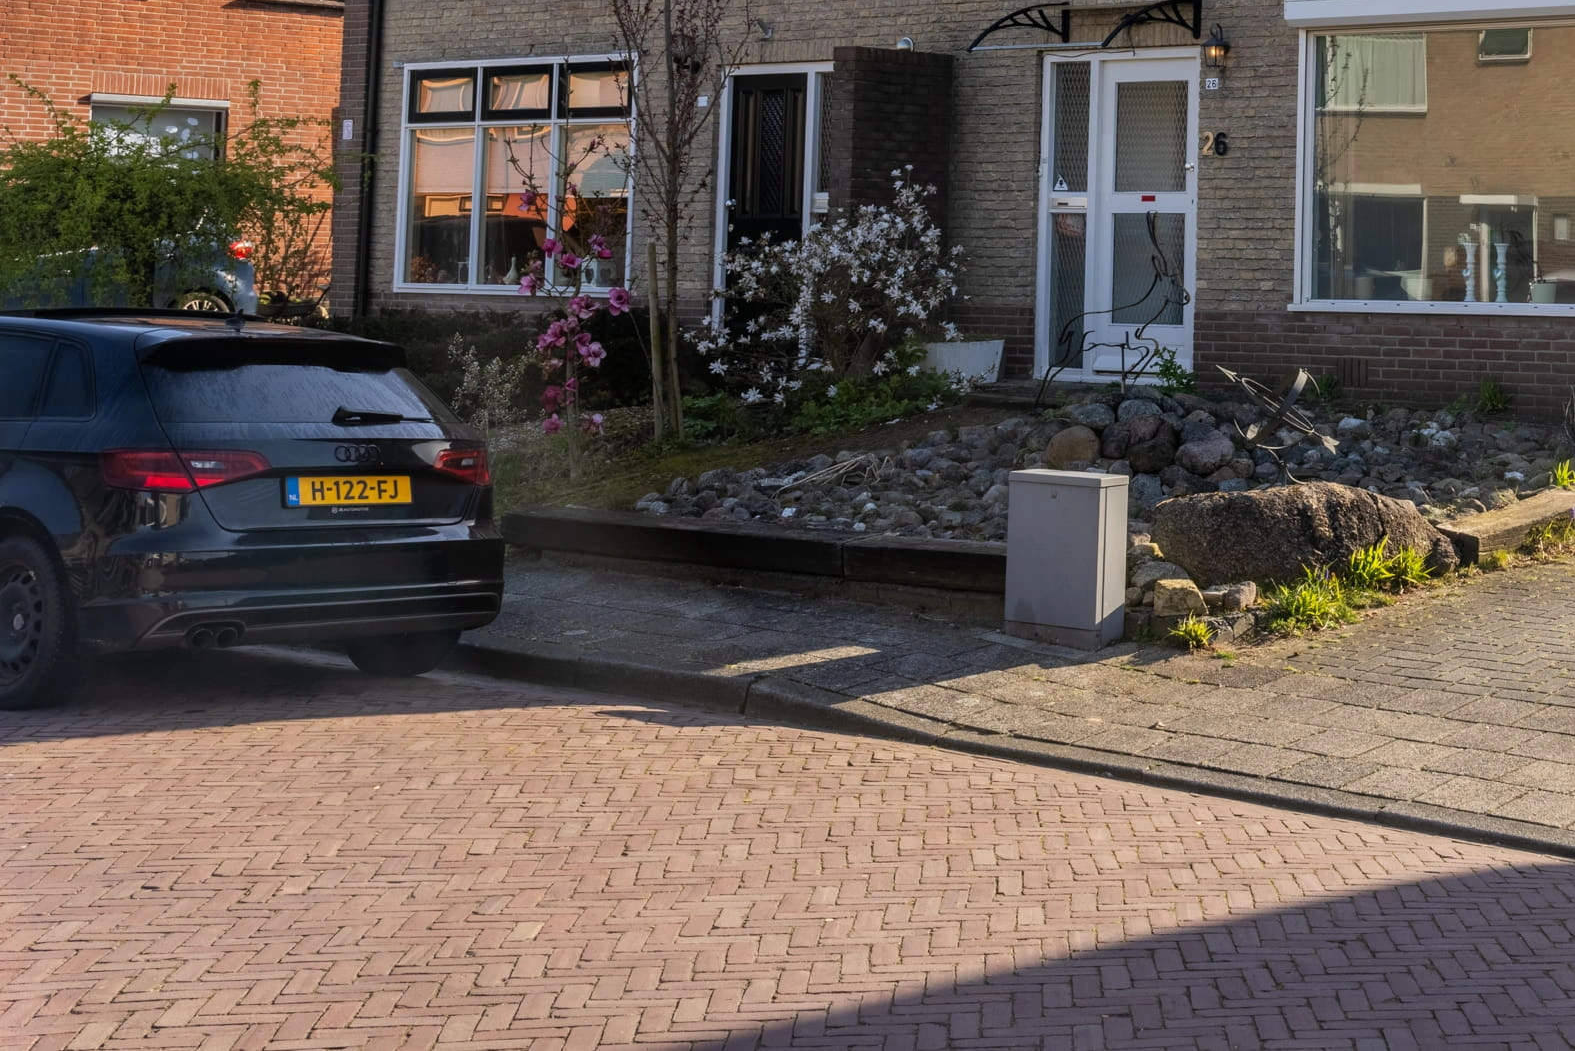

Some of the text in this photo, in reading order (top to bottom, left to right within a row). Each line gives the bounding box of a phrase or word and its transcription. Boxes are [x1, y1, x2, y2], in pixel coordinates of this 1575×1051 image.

[1207, 79, 1217, 88] 26
[1201, 131, 1227, 156] 26
[311, 480, 398, 501] H-122-FJ
